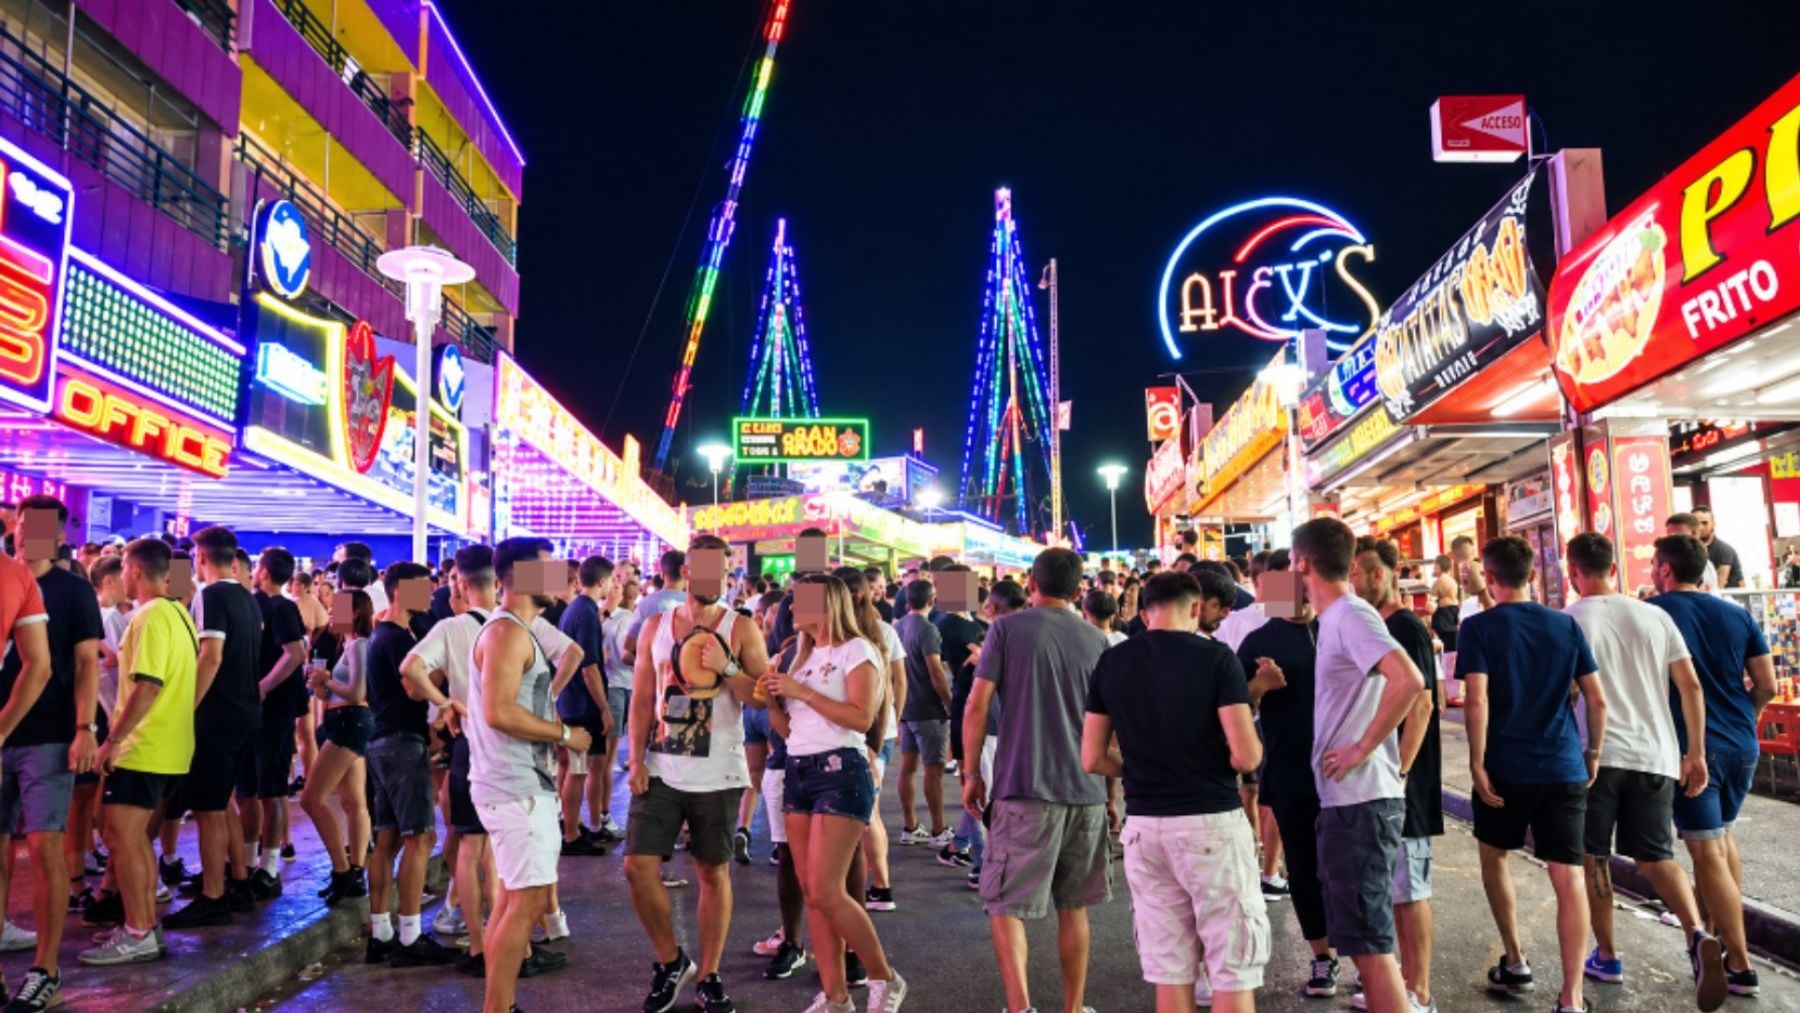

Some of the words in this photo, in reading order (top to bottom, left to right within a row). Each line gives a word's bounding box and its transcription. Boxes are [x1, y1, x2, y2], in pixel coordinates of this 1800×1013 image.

[1481, 116, 1521, 130] ACCESO
[1680, 259, 1779, 340] FRITO
[61, 378, 230, 479] OFFICE
